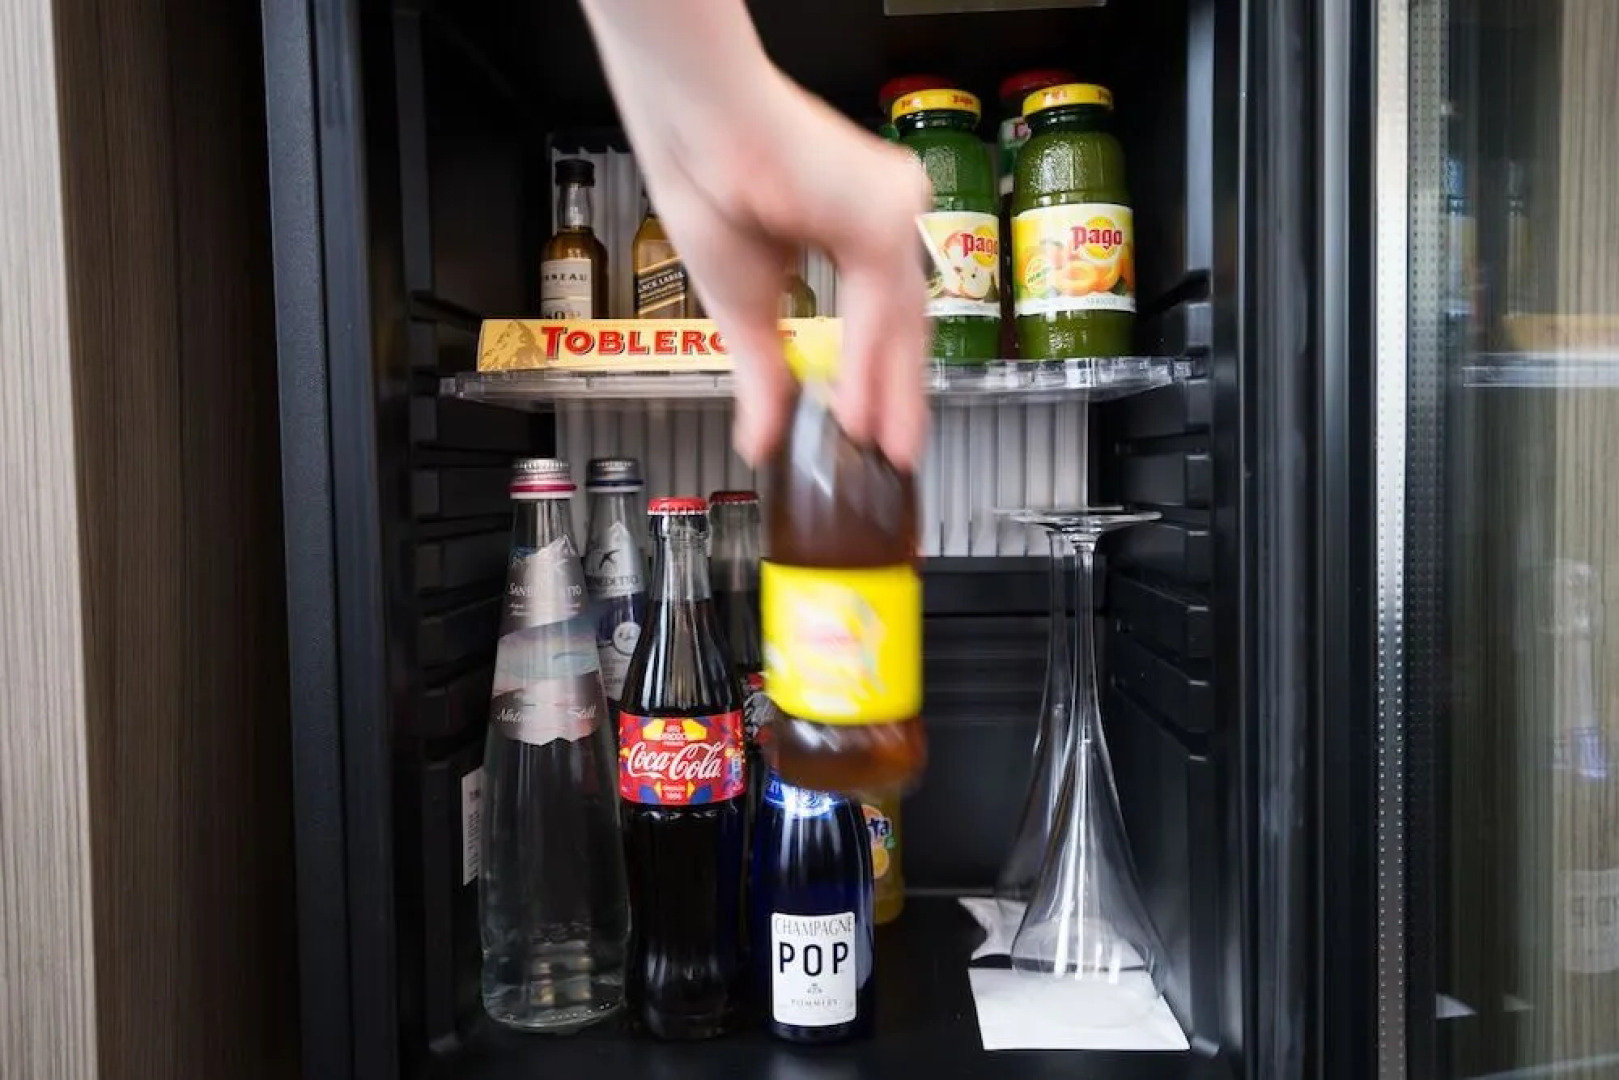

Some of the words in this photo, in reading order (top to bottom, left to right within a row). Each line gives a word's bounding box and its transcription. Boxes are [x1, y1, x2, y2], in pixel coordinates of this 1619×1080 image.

[541, 326, 797, 360] TOBLERO
[627, 741, 725, 781] Coca-Cola
[775, 915, 854, 937] CHAMPAGNE
[779, 941, 849, 977] POP
